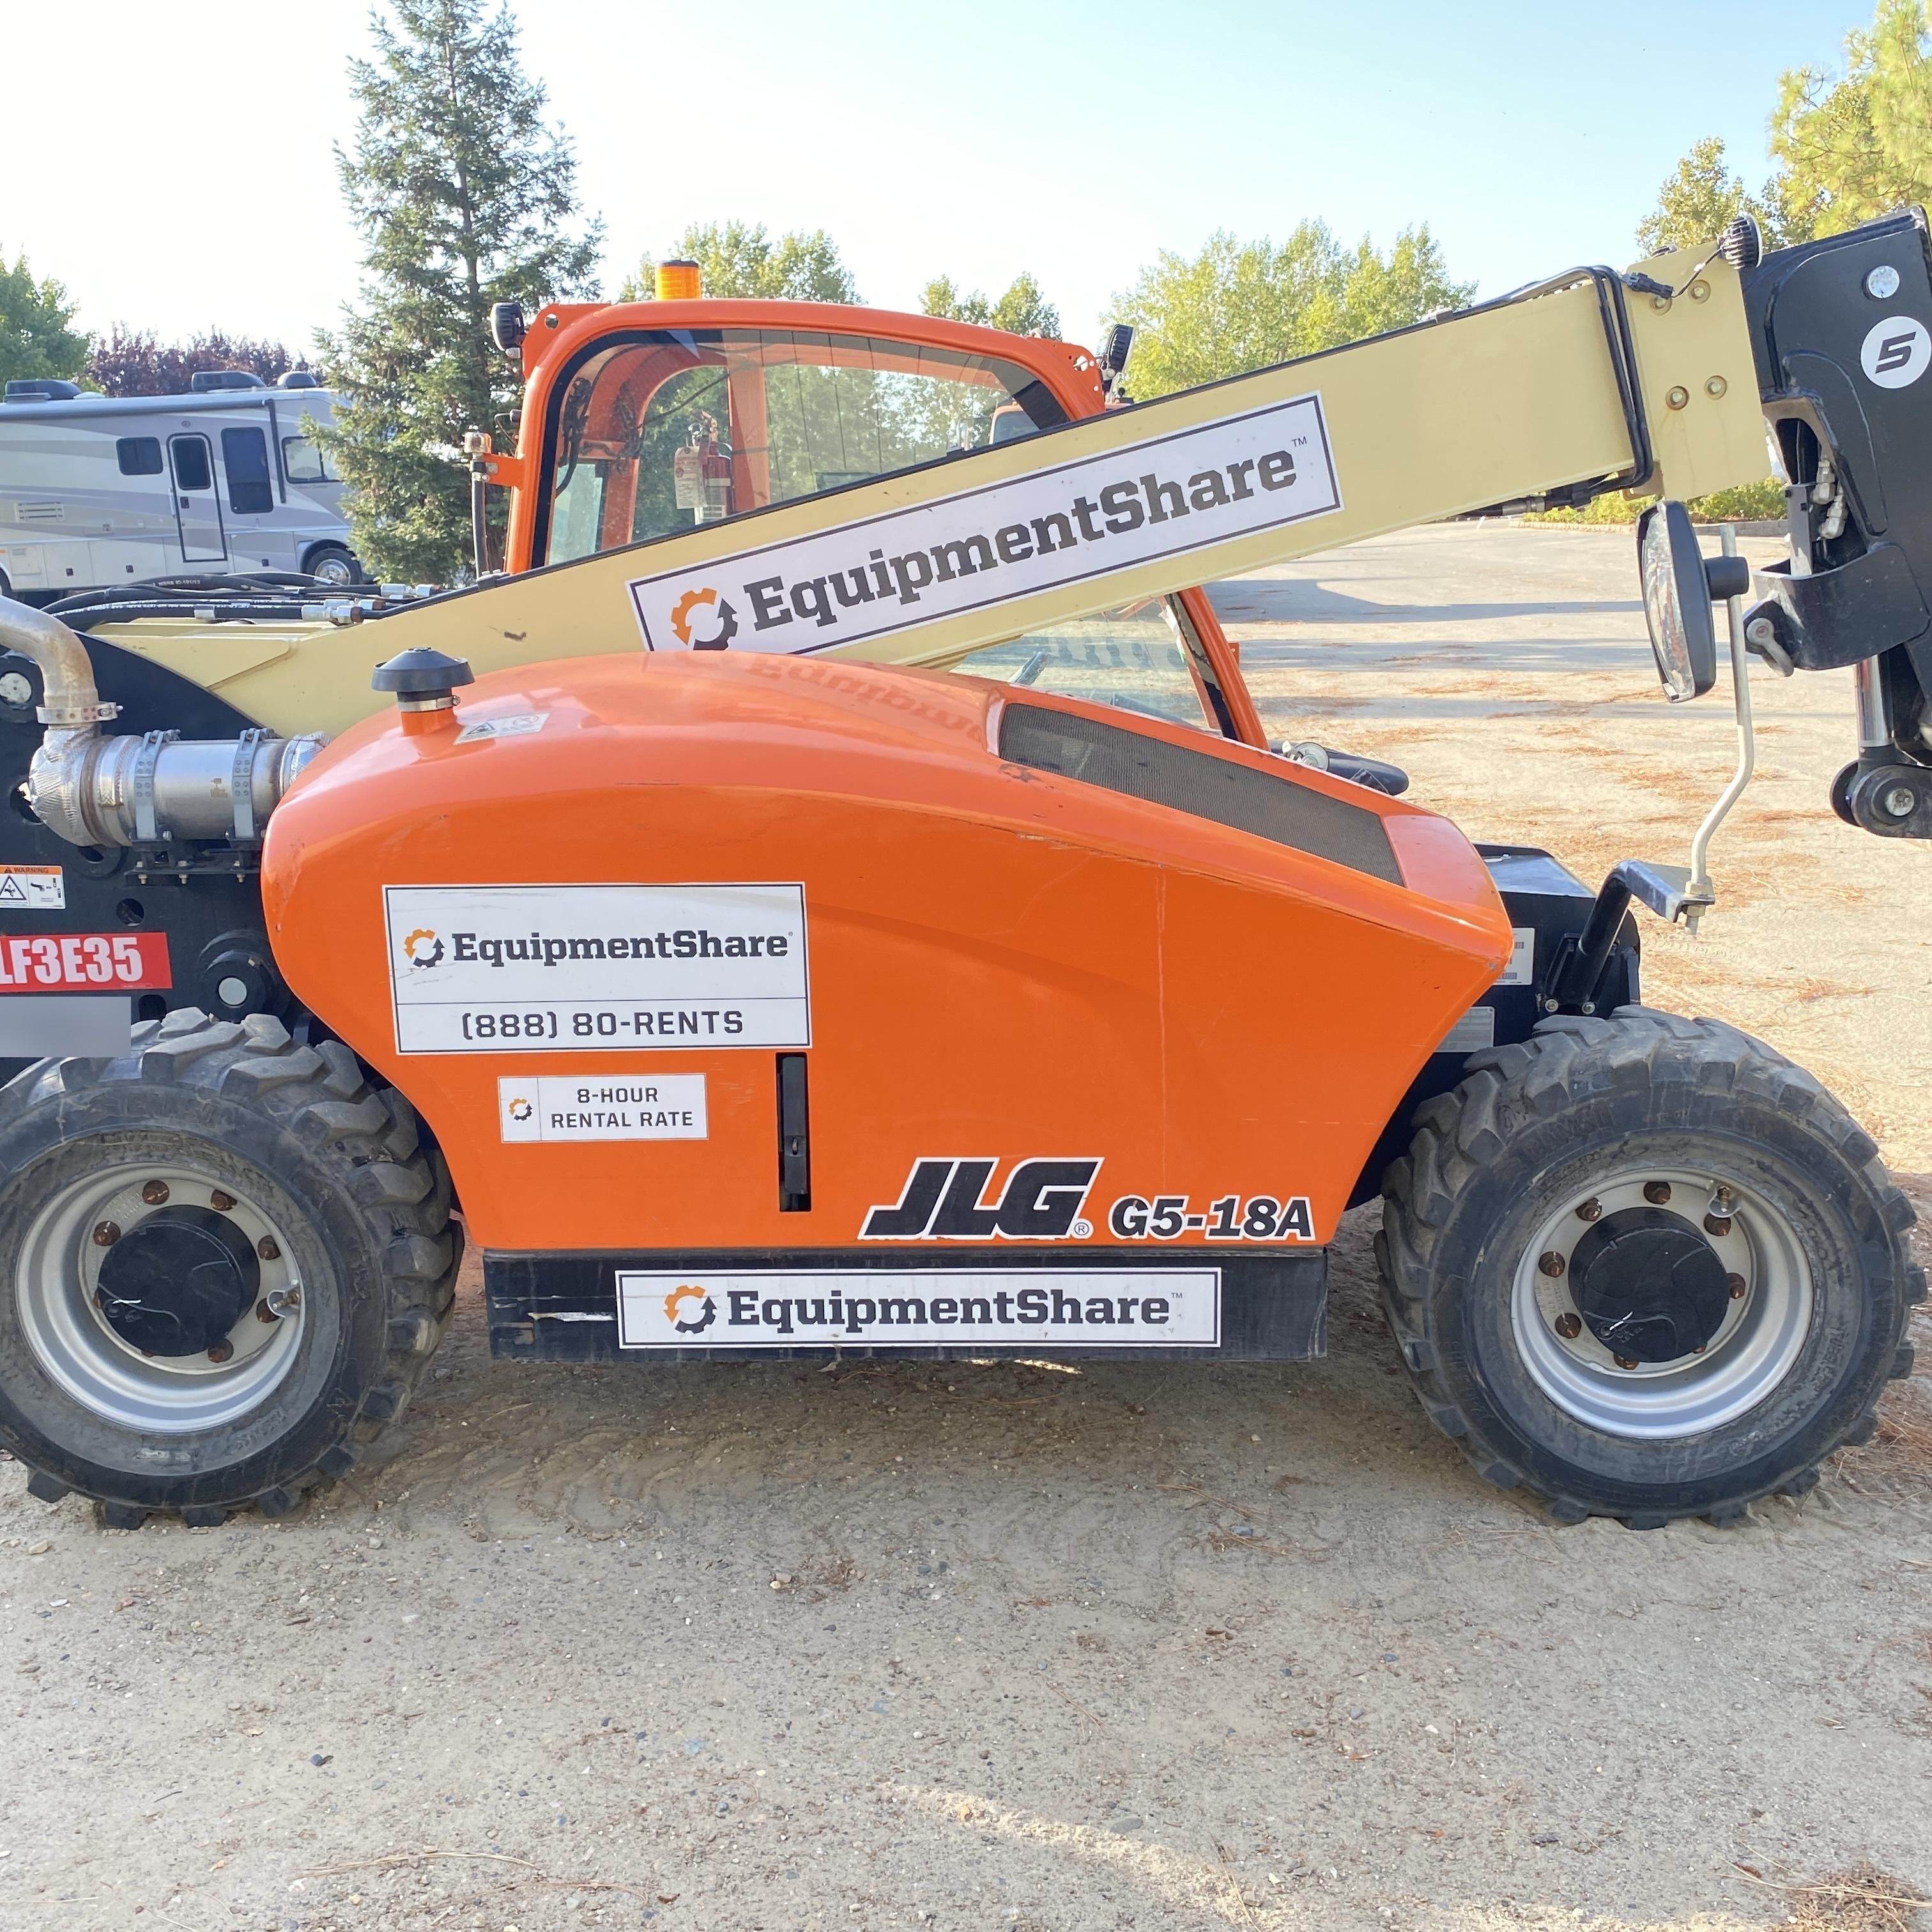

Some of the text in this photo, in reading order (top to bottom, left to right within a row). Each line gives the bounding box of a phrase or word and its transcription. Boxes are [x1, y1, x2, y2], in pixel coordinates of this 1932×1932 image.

[743, 449, 1297, 632] EquipmentShare
[452, 930, 788, 967] EquipmentShare
[462, 1011, 743, 1040] (888) 80-RENTS
[577, 1087, 658, 1103] 8-HOUR
[551, 1111, 693, 1128] RENTAL RATE
[858, 1157, 1105, 1240] JLG
[1108, 1195, 1315, 1240] G5-18A
[727, 1289, 1169, 1333] EquipmentShare
